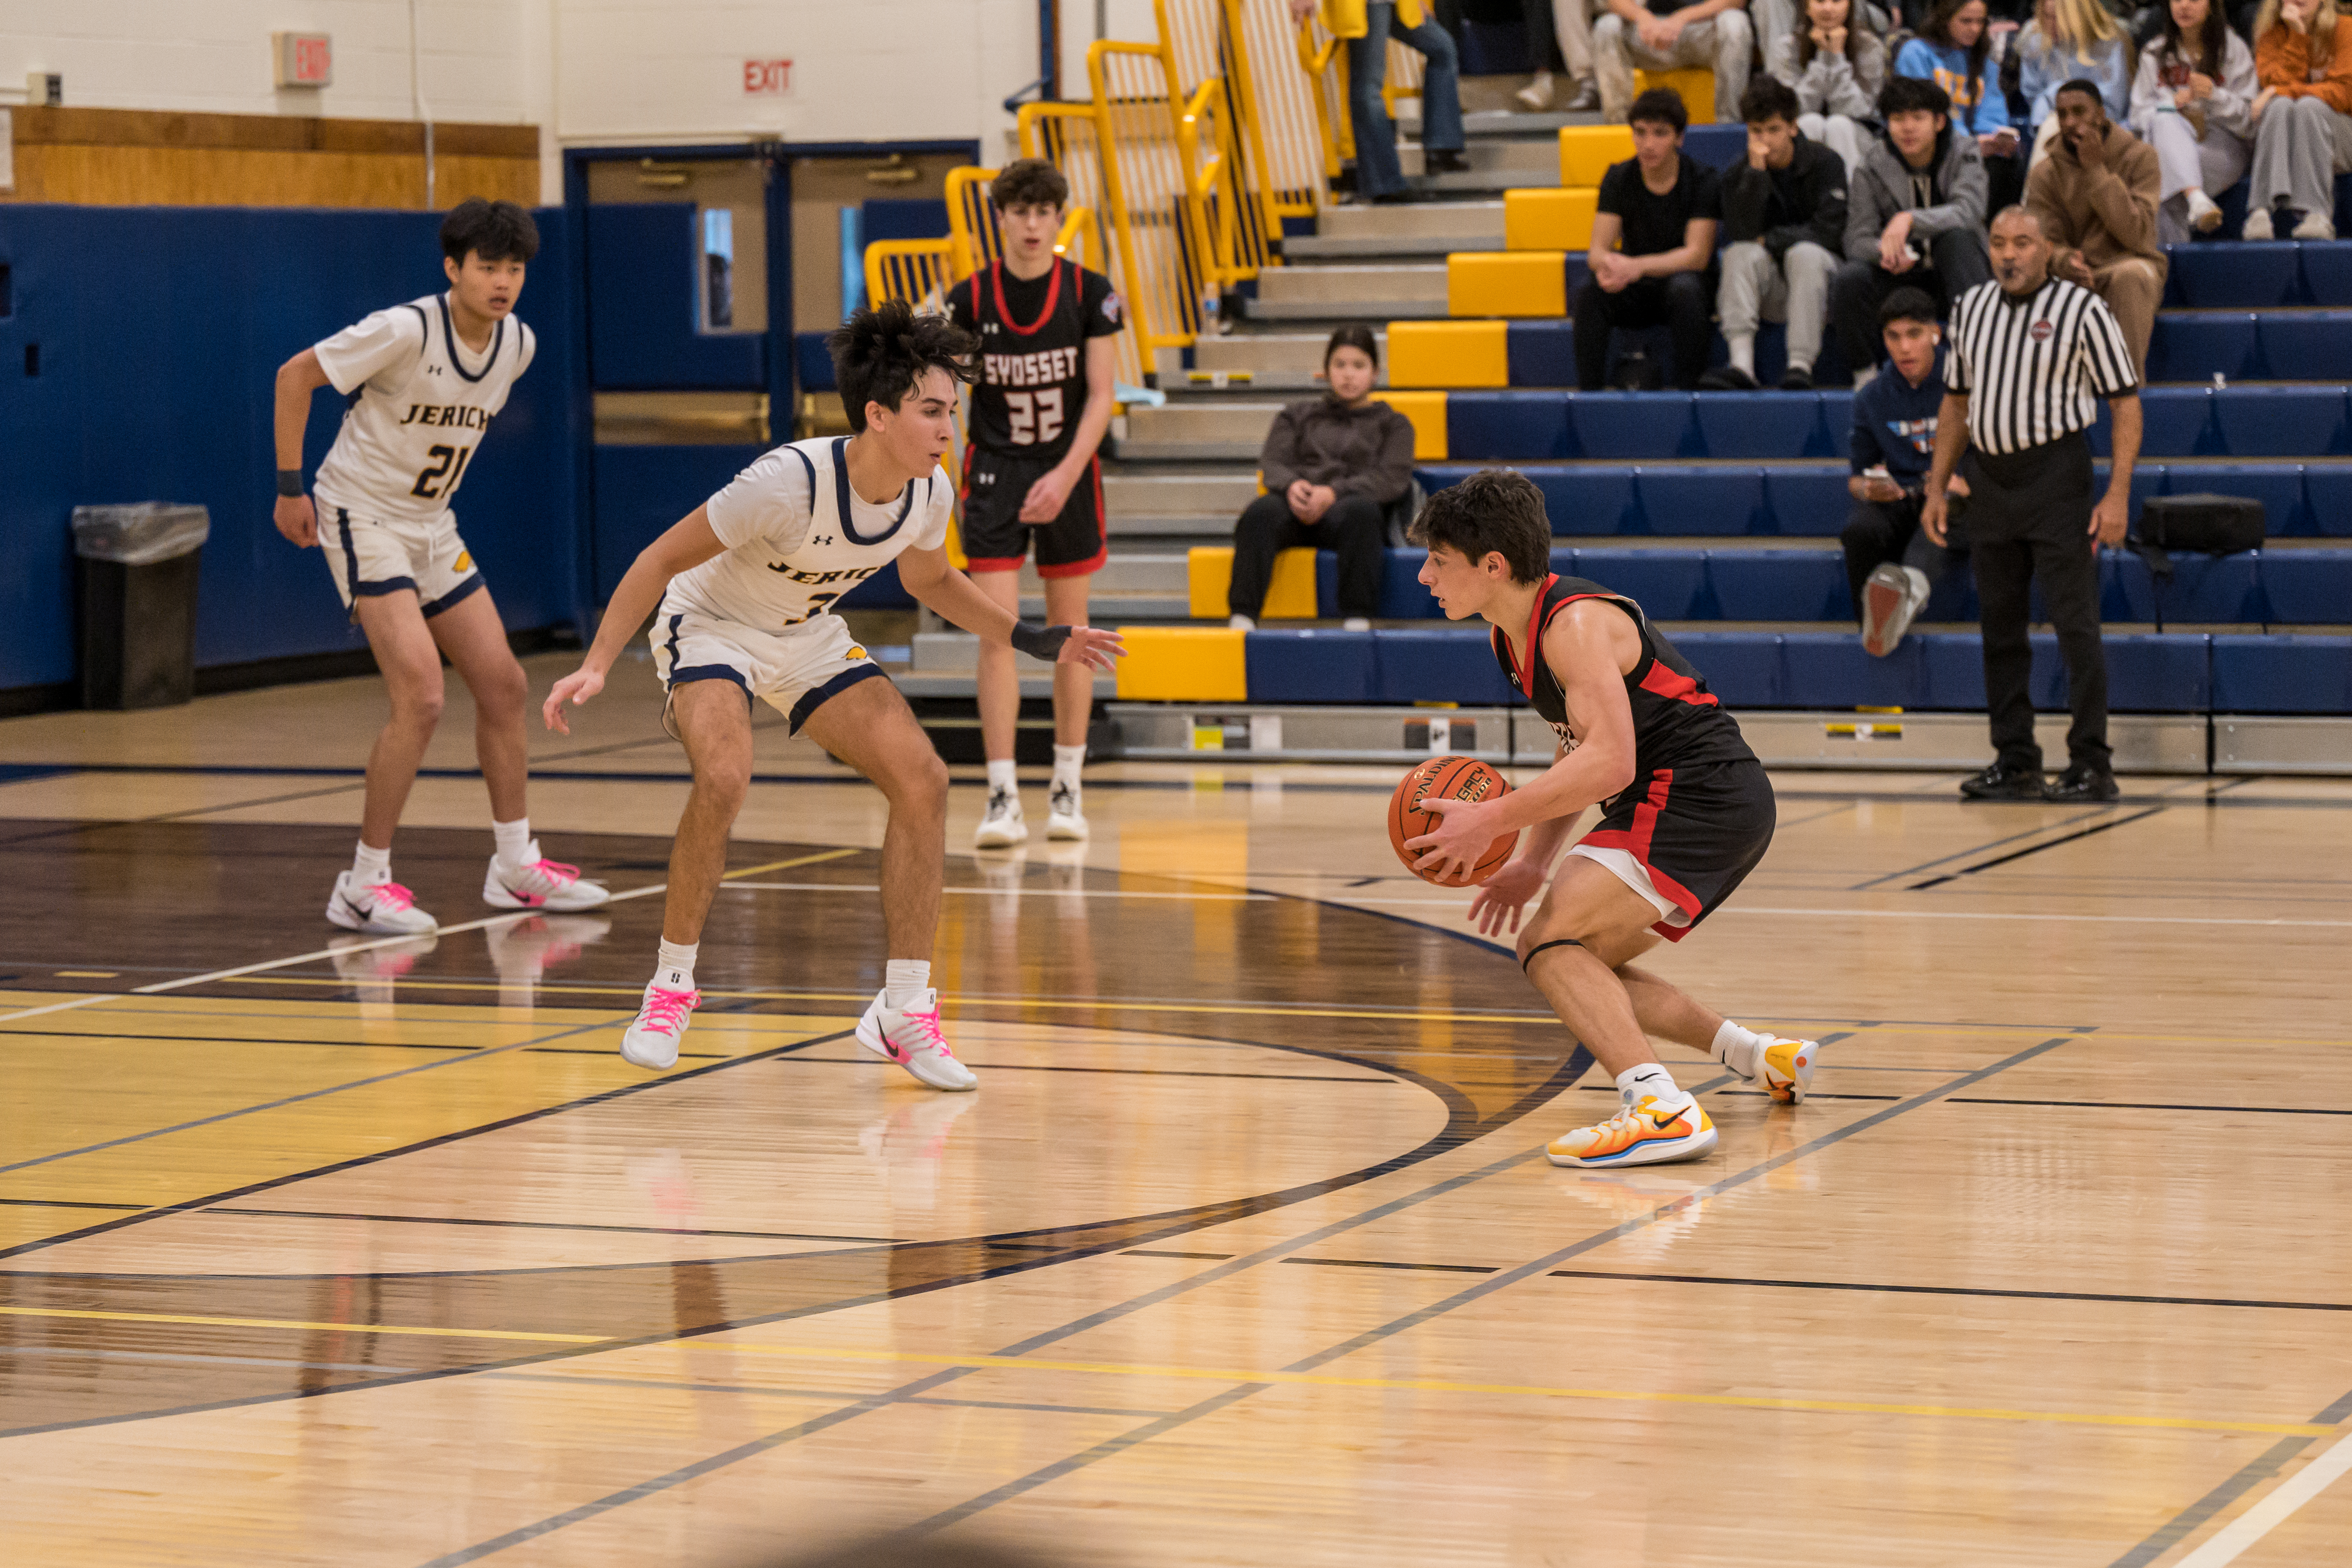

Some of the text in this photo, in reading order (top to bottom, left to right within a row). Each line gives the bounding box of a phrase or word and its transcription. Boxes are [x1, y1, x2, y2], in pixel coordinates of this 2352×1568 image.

[743, 60, 794, 92] EXIT
[983, 346, 1079, 386] SYOSSET
[1004, 388, 1065, 446] 22
[410, 444, 470, 499] 21
[767, 561, 886, 585] JERIC
